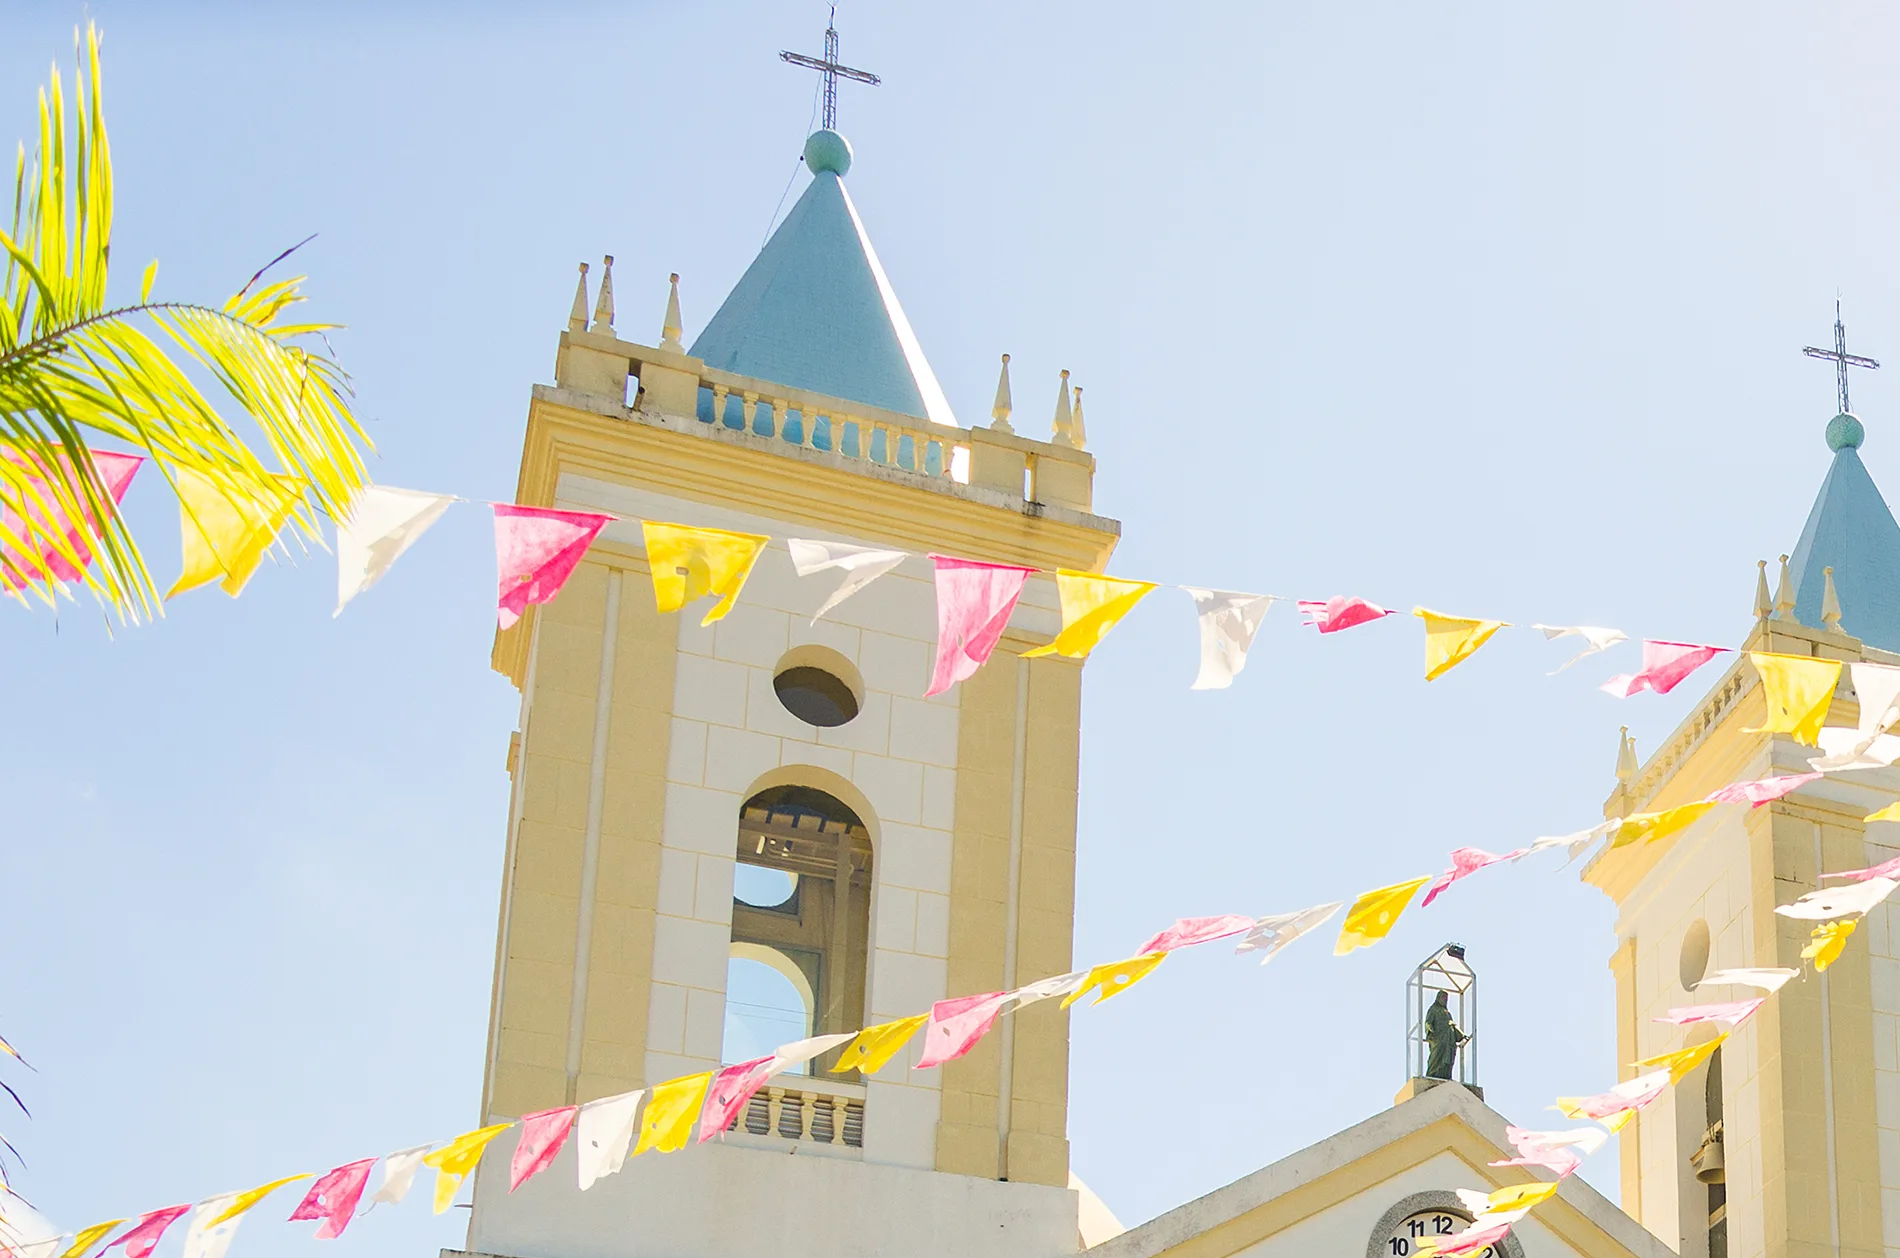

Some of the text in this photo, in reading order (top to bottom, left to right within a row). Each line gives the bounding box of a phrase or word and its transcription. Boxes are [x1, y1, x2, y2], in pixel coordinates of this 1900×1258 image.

[1407, 1219, 1424, 1238] 11
[1432, 1215, 1453, 1235] 12
[1389, 1237, 1409, 1257] 10
